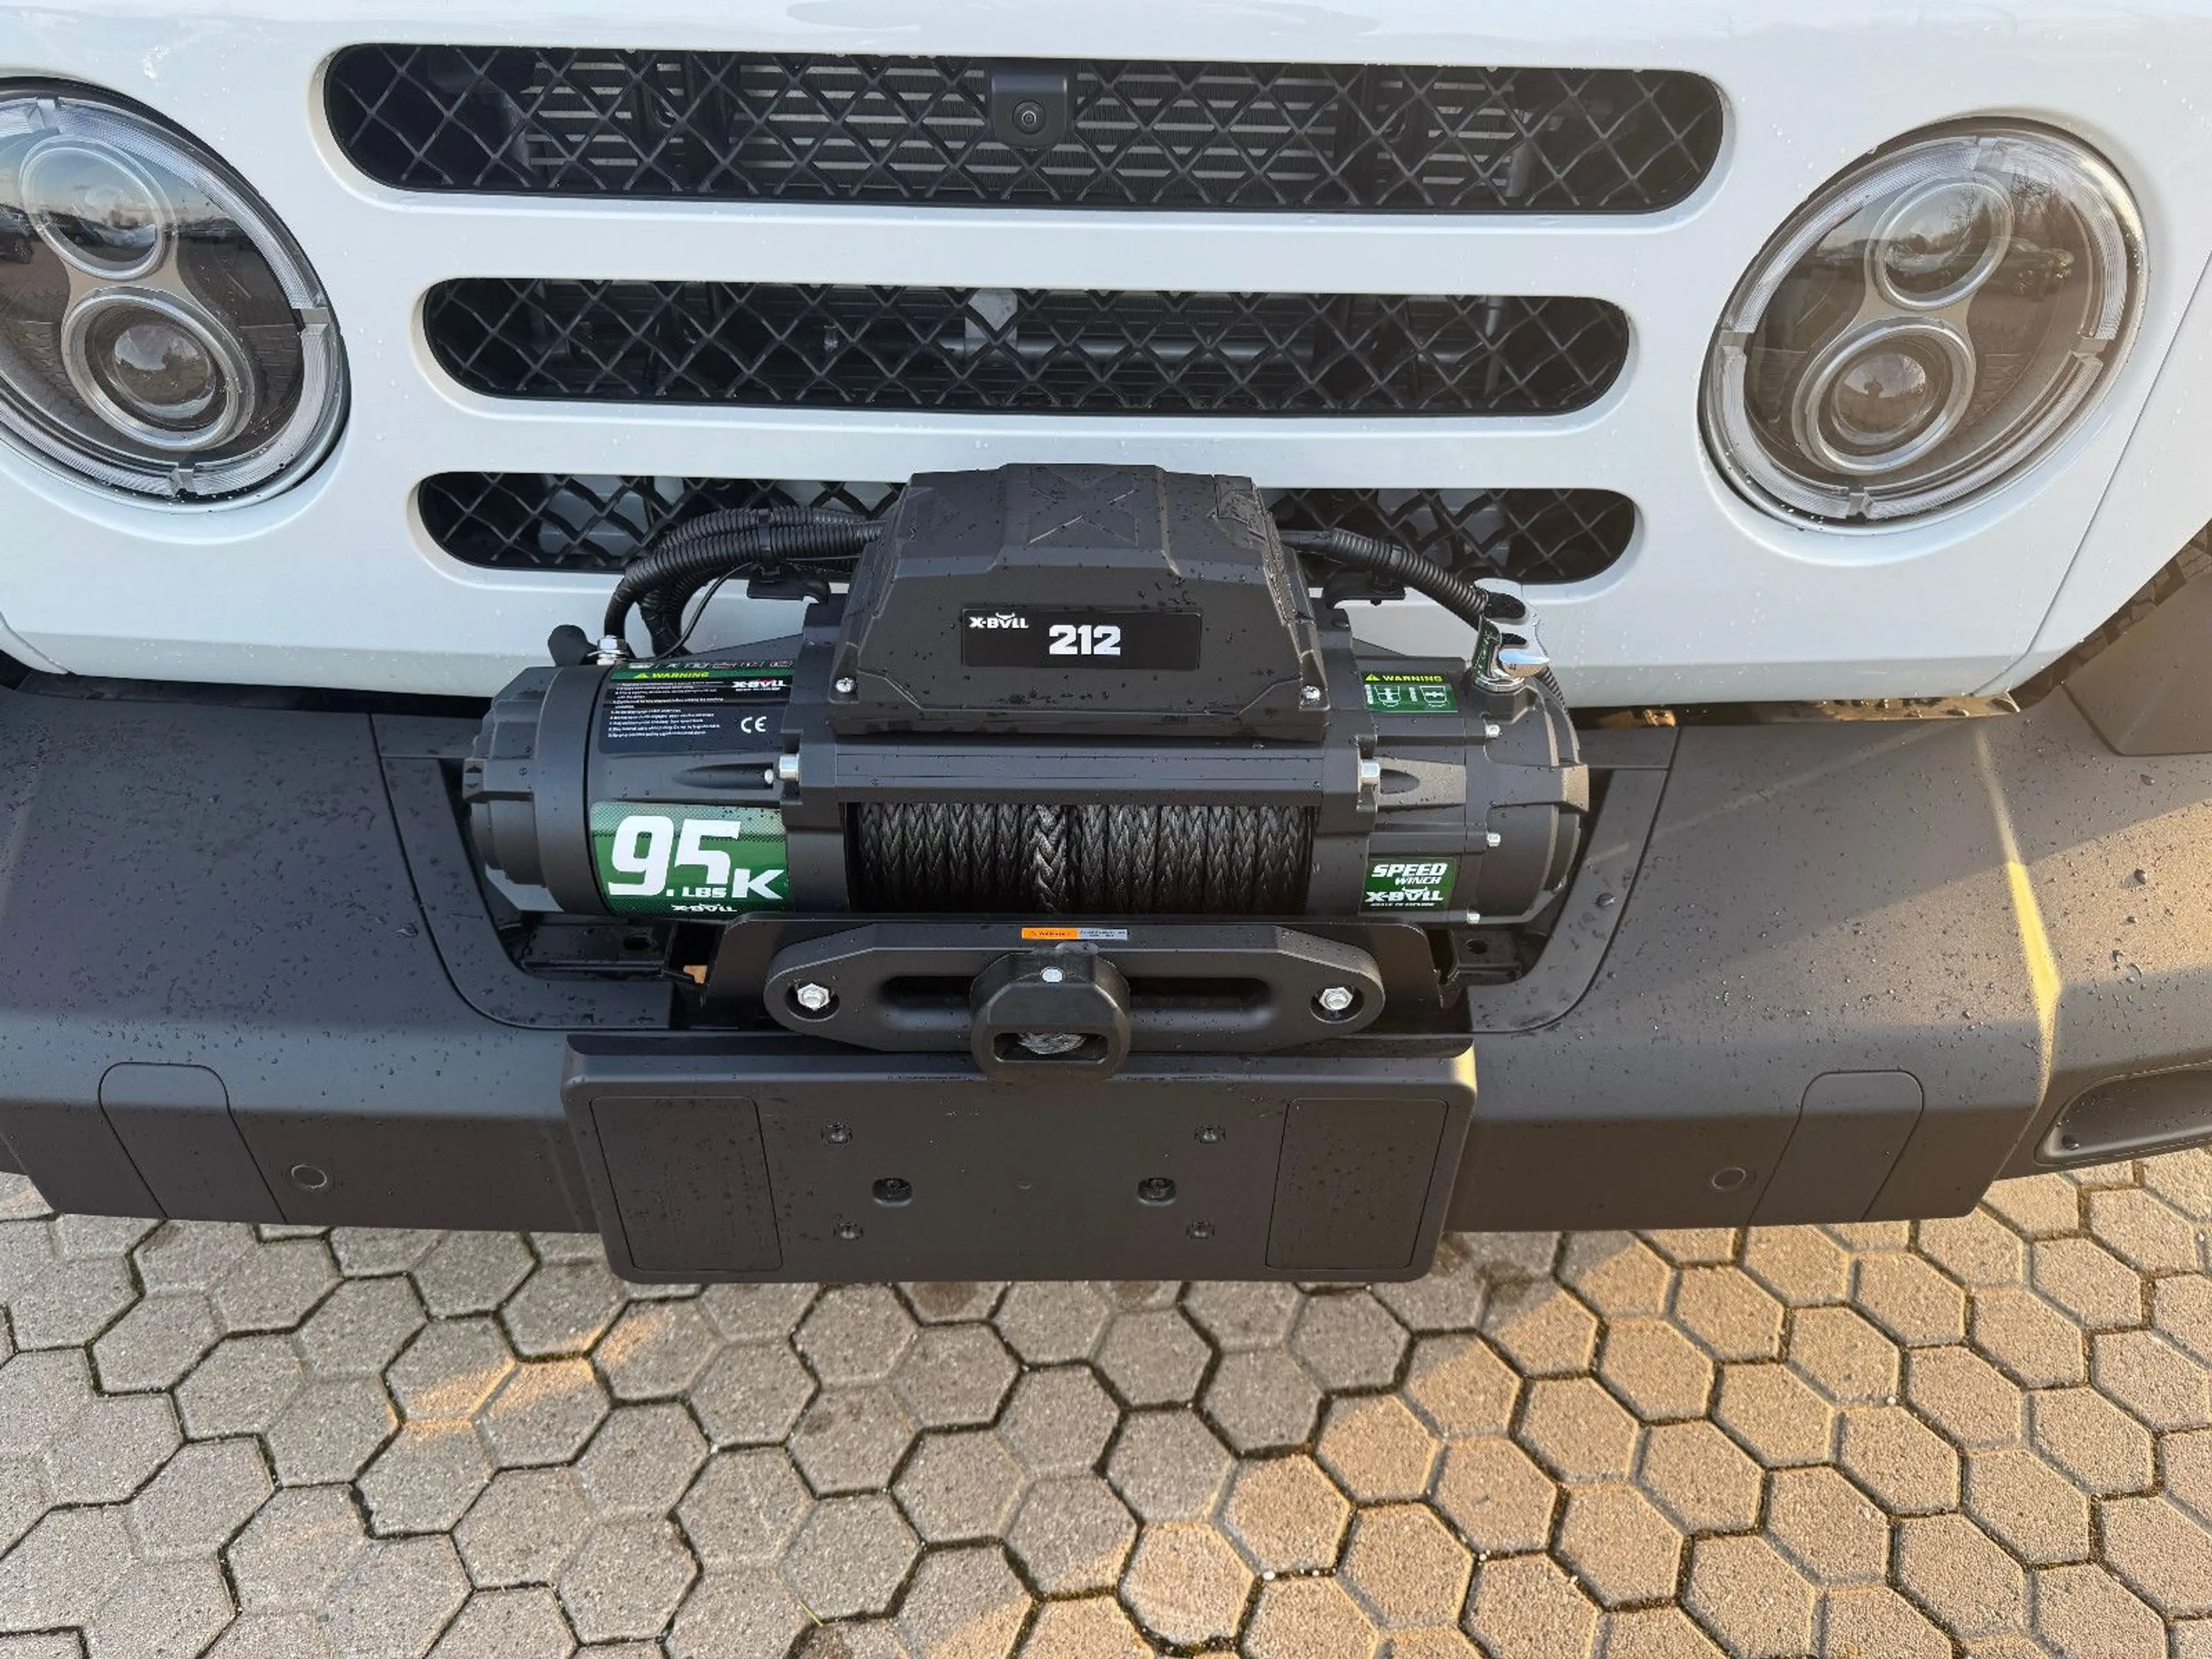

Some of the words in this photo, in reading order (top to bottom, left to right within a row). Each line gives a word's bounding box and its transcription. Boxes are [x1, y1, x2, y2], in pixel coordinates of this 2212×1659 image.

[1048, 624, 1121, 656] 212
[1382, 675, 1443, 683] WARNING
[741, 715, 767, 733] CE
[1371, 862, 1448, 877] SPEED
[1395, 876, 1442, 885] WINCH
[681, 886, 727, 898] LBS
